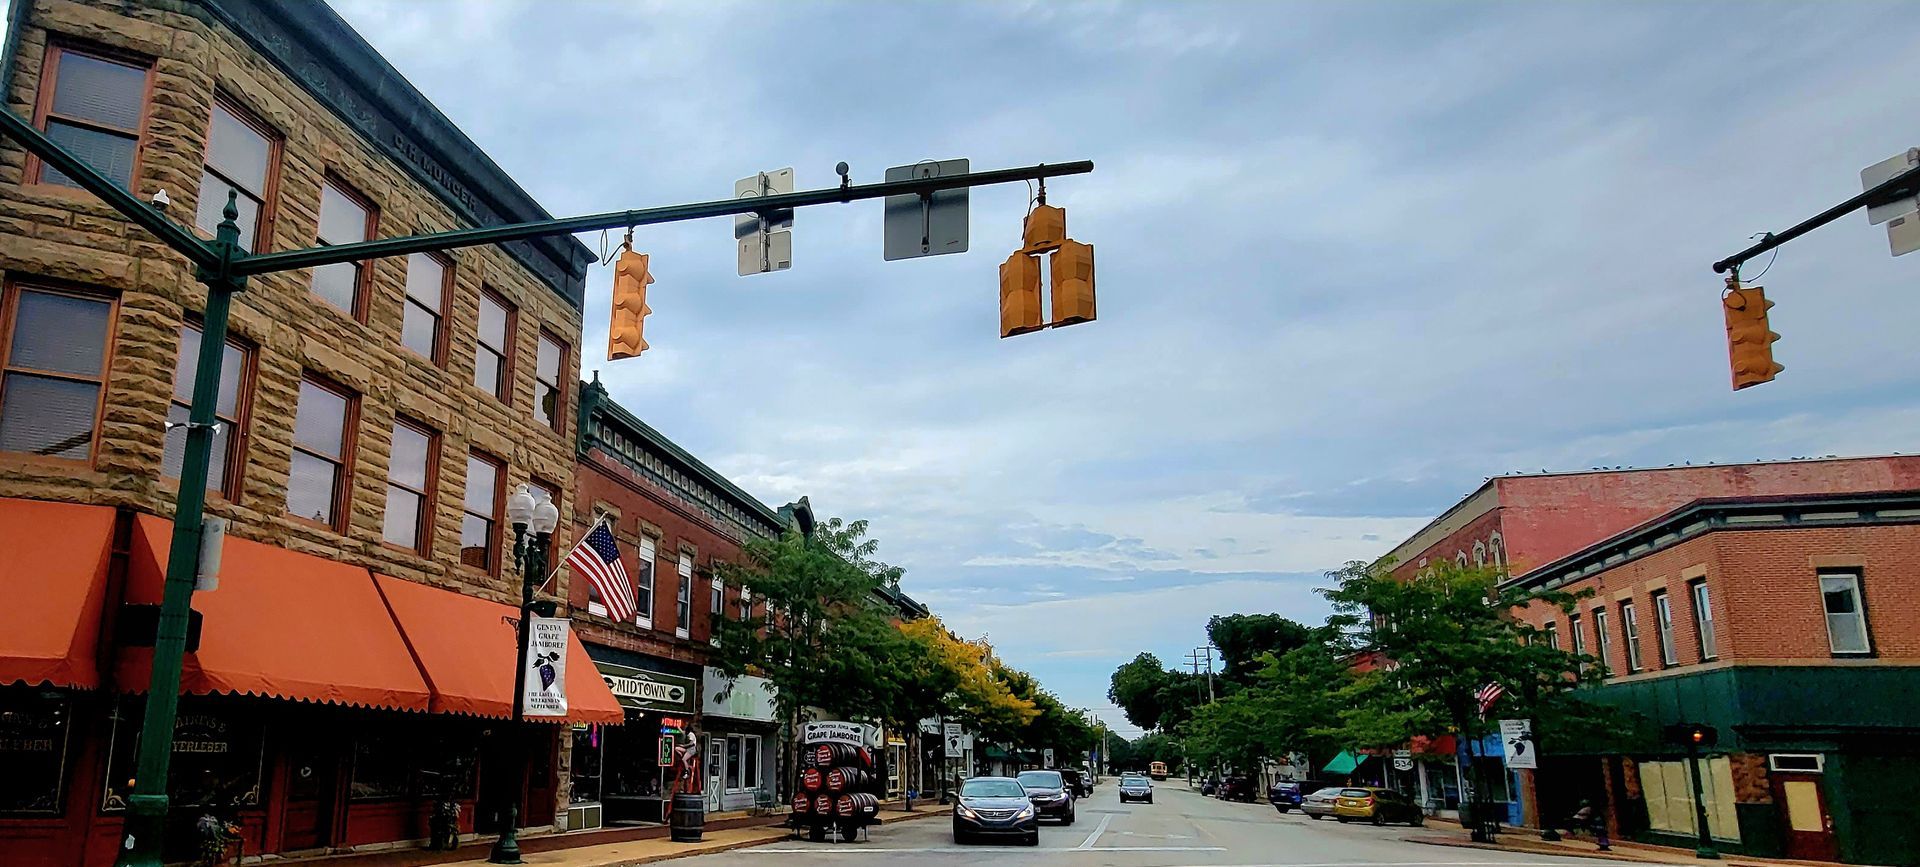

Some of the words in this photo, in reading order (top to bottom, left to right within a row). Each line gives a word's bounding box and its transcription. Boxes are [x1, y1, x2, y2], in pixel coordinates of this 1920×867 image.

[536, 623, 562, 631] GENEVA
[538, 632, 560, 640] GRAPE
[531, 640, 565, 649] JAMBOREE
[616, 679, 666, 698] MIDTOWN
[807, 730, 828, 741] GRAPE
[828, 730, 861, 743] JAMBOREE
[172, 740, 228, 752] YERLEBER
[1395, 760, 1412, 768] 534
